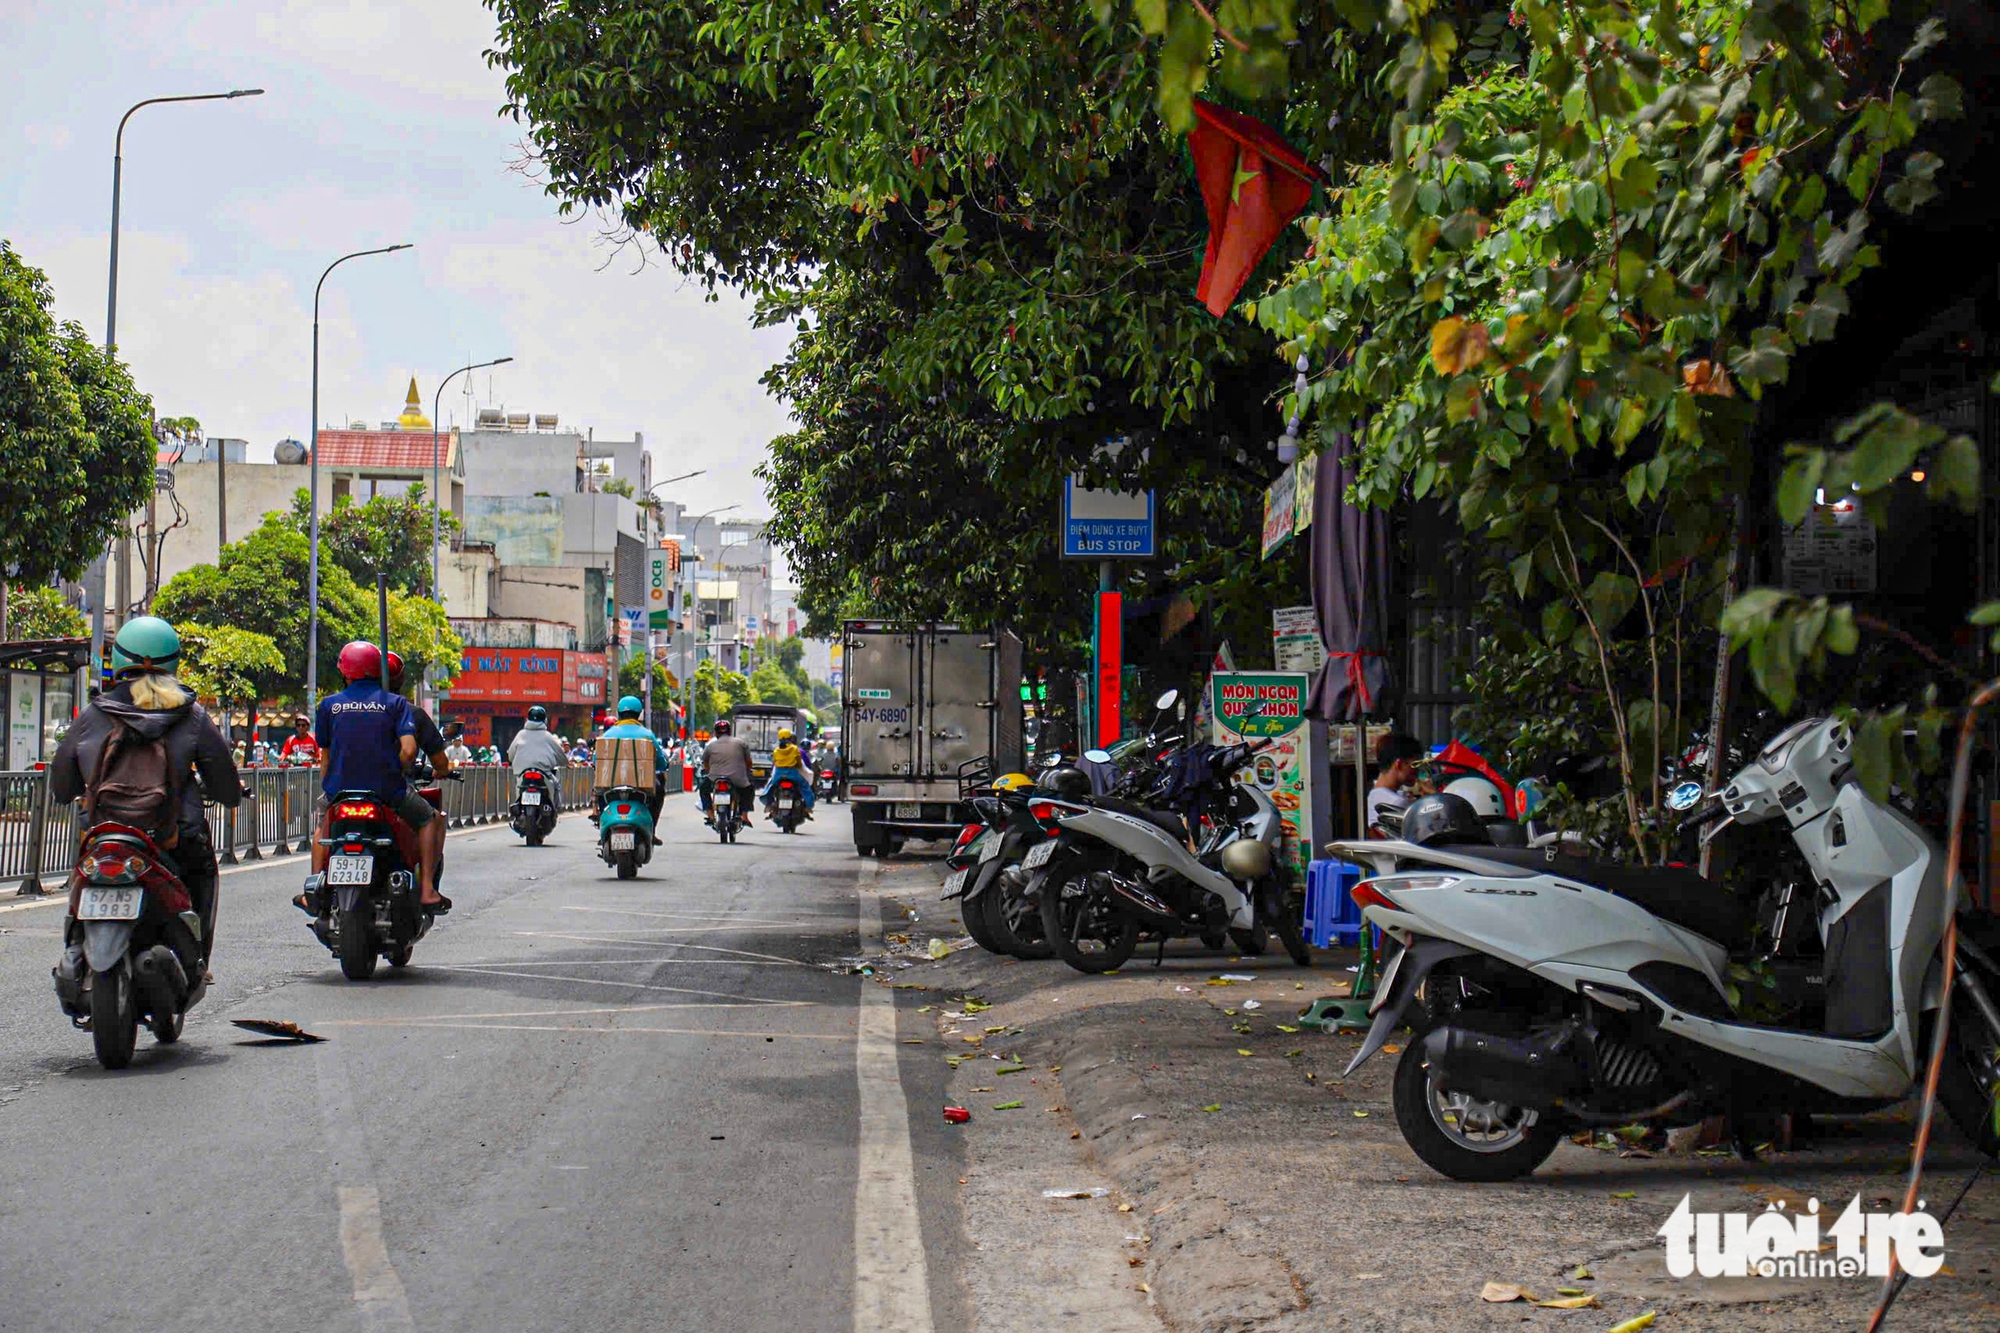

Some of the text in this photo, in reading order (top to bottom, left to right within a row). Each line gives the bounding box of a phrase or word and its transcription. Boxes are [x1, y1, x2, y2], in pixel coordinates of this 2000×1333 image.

[1116, 525, 1126, 535] XE
[1078, 540, 1141, 551] BUS STOP
[651, 559, 662, 587] OCB
[519, 653, 559, 673] KÍNH
[1222, 682, 1255, 699] MÓN
[854, 708, 907, 723] 54Y-6890
[336, 859, 367, 870] 59-T2
[332, 871, 368, 883] 623.48
[90, 890, 132, 902] 67-N5
[1464, 888, 1538, 897] LEAD
[88, 903, 131, 917] 1983
